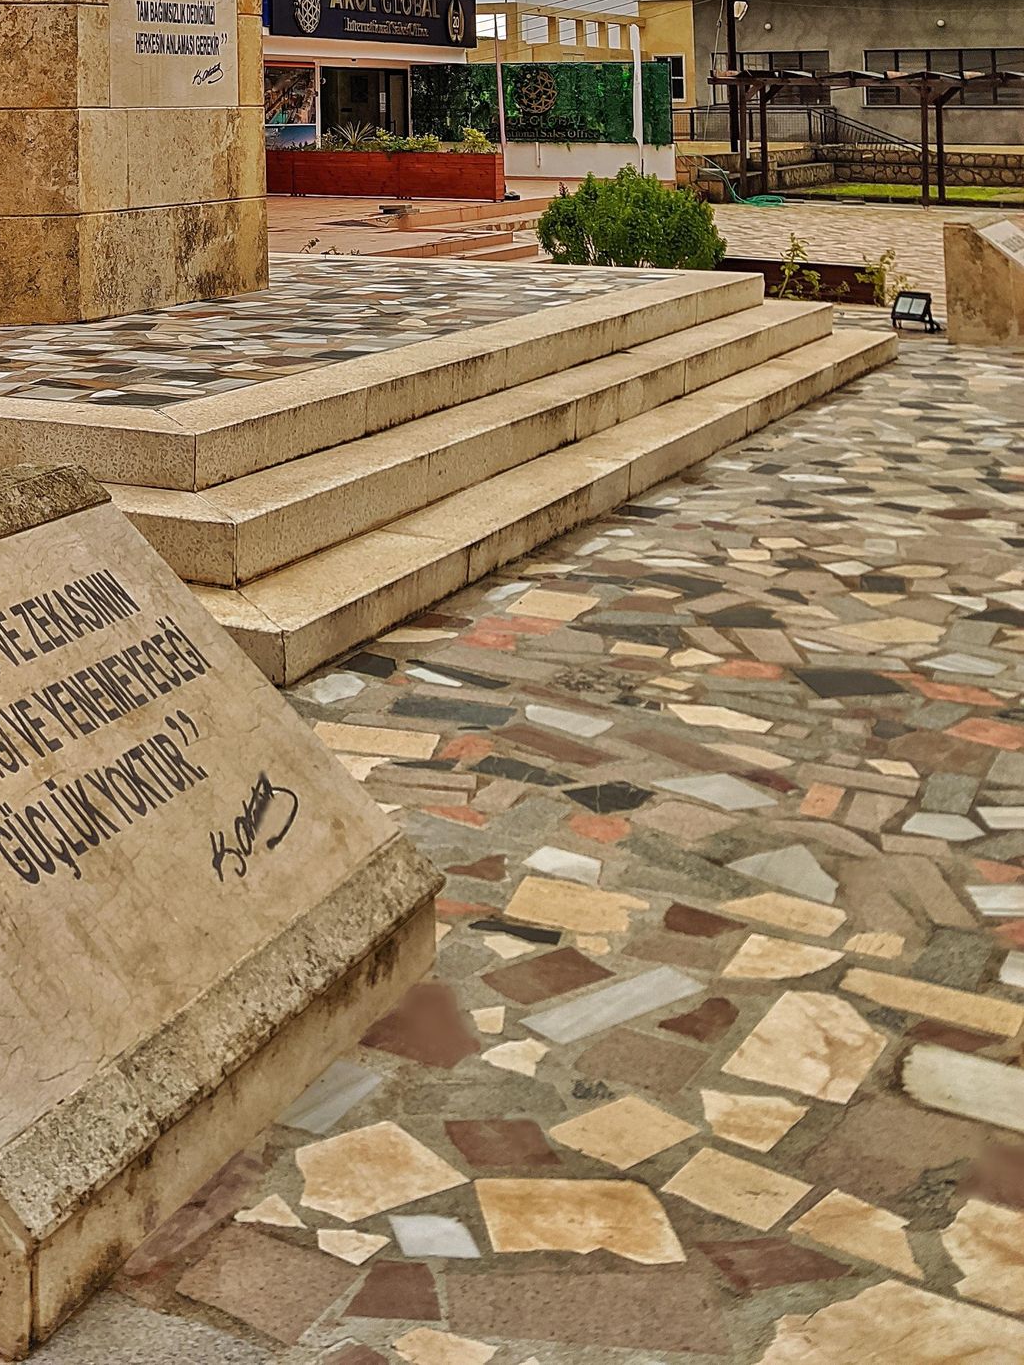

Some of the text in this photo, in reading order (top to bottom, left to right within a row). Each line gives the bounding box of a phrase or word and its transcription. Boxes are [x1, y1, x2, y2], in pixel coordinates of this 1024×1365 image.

[136, 0, 149, 22] TAM
[136, 30, 165, 54] HERKESİN
[166, 34, 195, 55] ANLAMASI
[10, 569, 141, 654] ZEKASININ
[31, 615, 212, 742] YENEMEYECEĞİ
